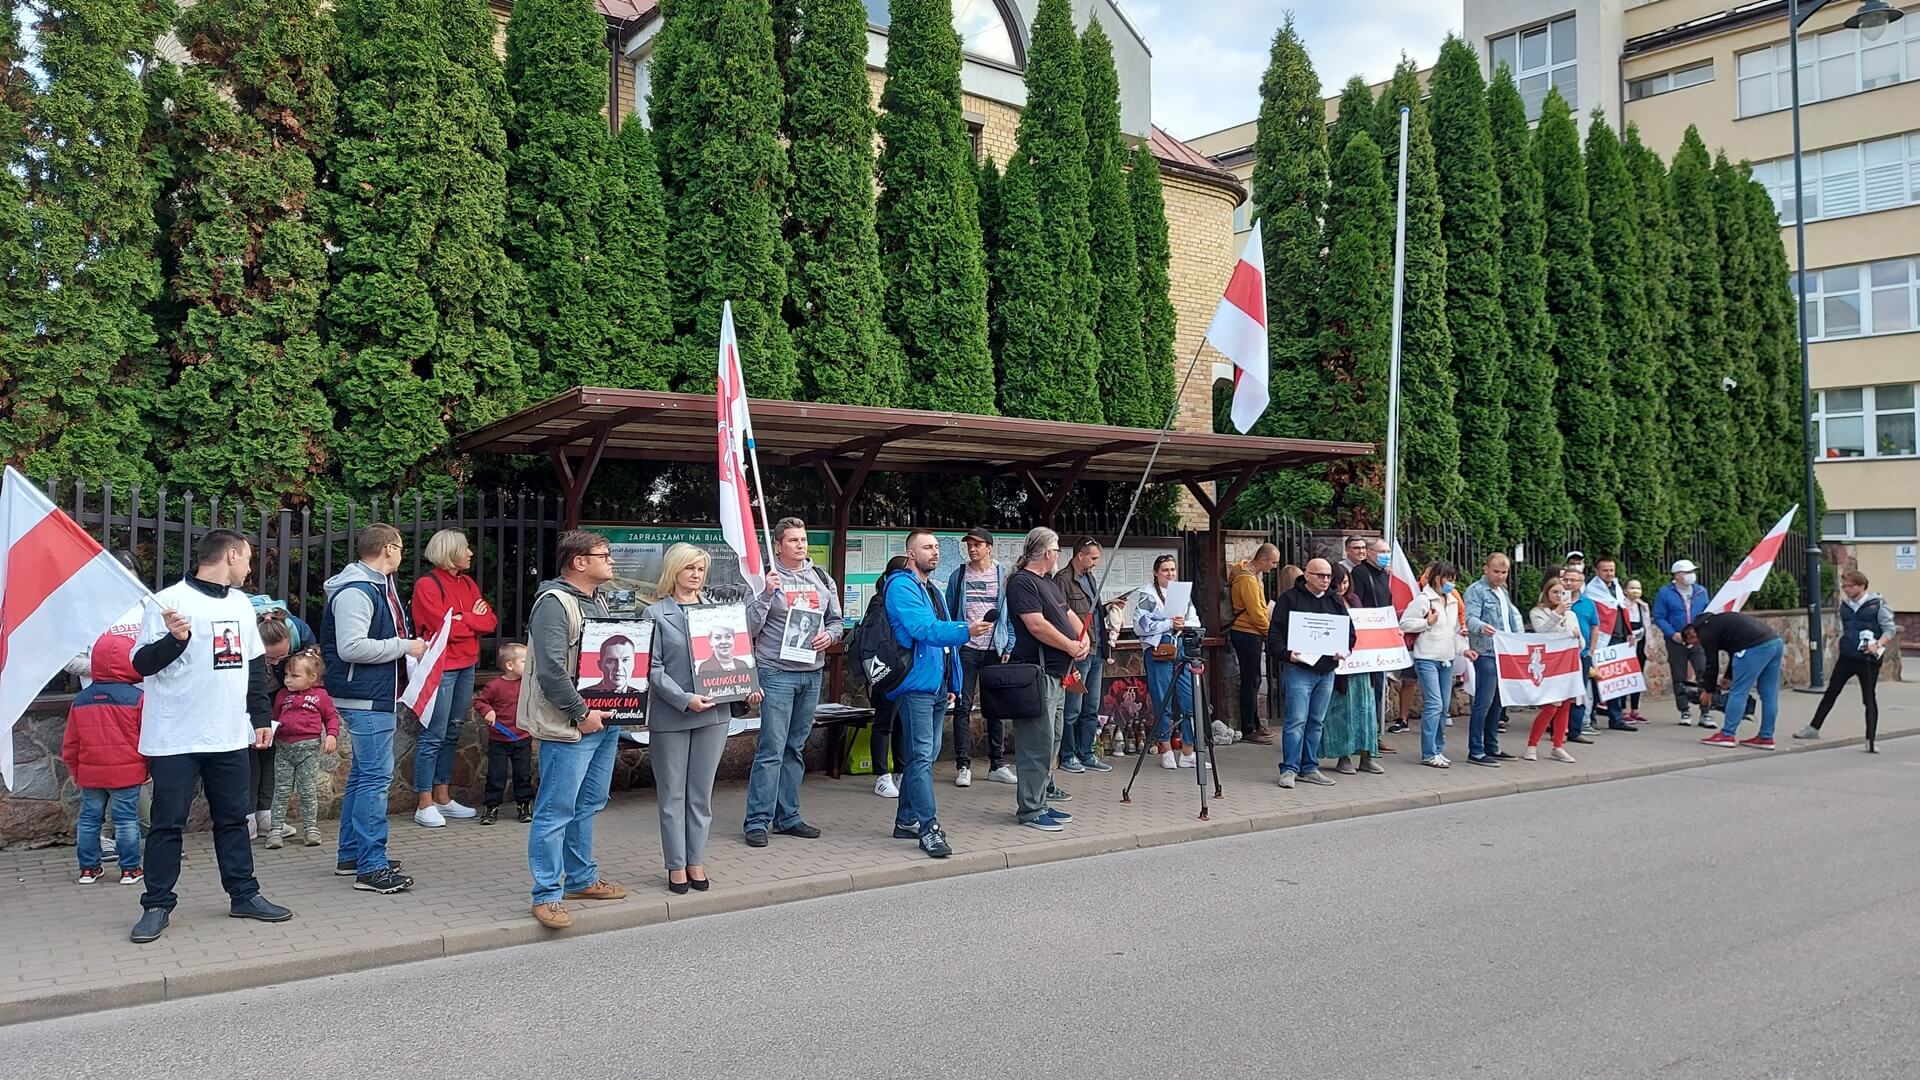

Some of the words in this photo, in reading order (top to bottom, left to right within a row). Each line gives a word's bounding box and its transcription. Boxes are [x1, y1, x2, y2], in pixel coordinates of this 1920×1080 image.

[628, 533, 685, 541] ZAPRASZAMY
[688, 533, 701, 541] NA
[737, 674, 752, 683] DLA
[870, 665, 893, 687] Reebok
[623, 697, 639, 708] DLA
